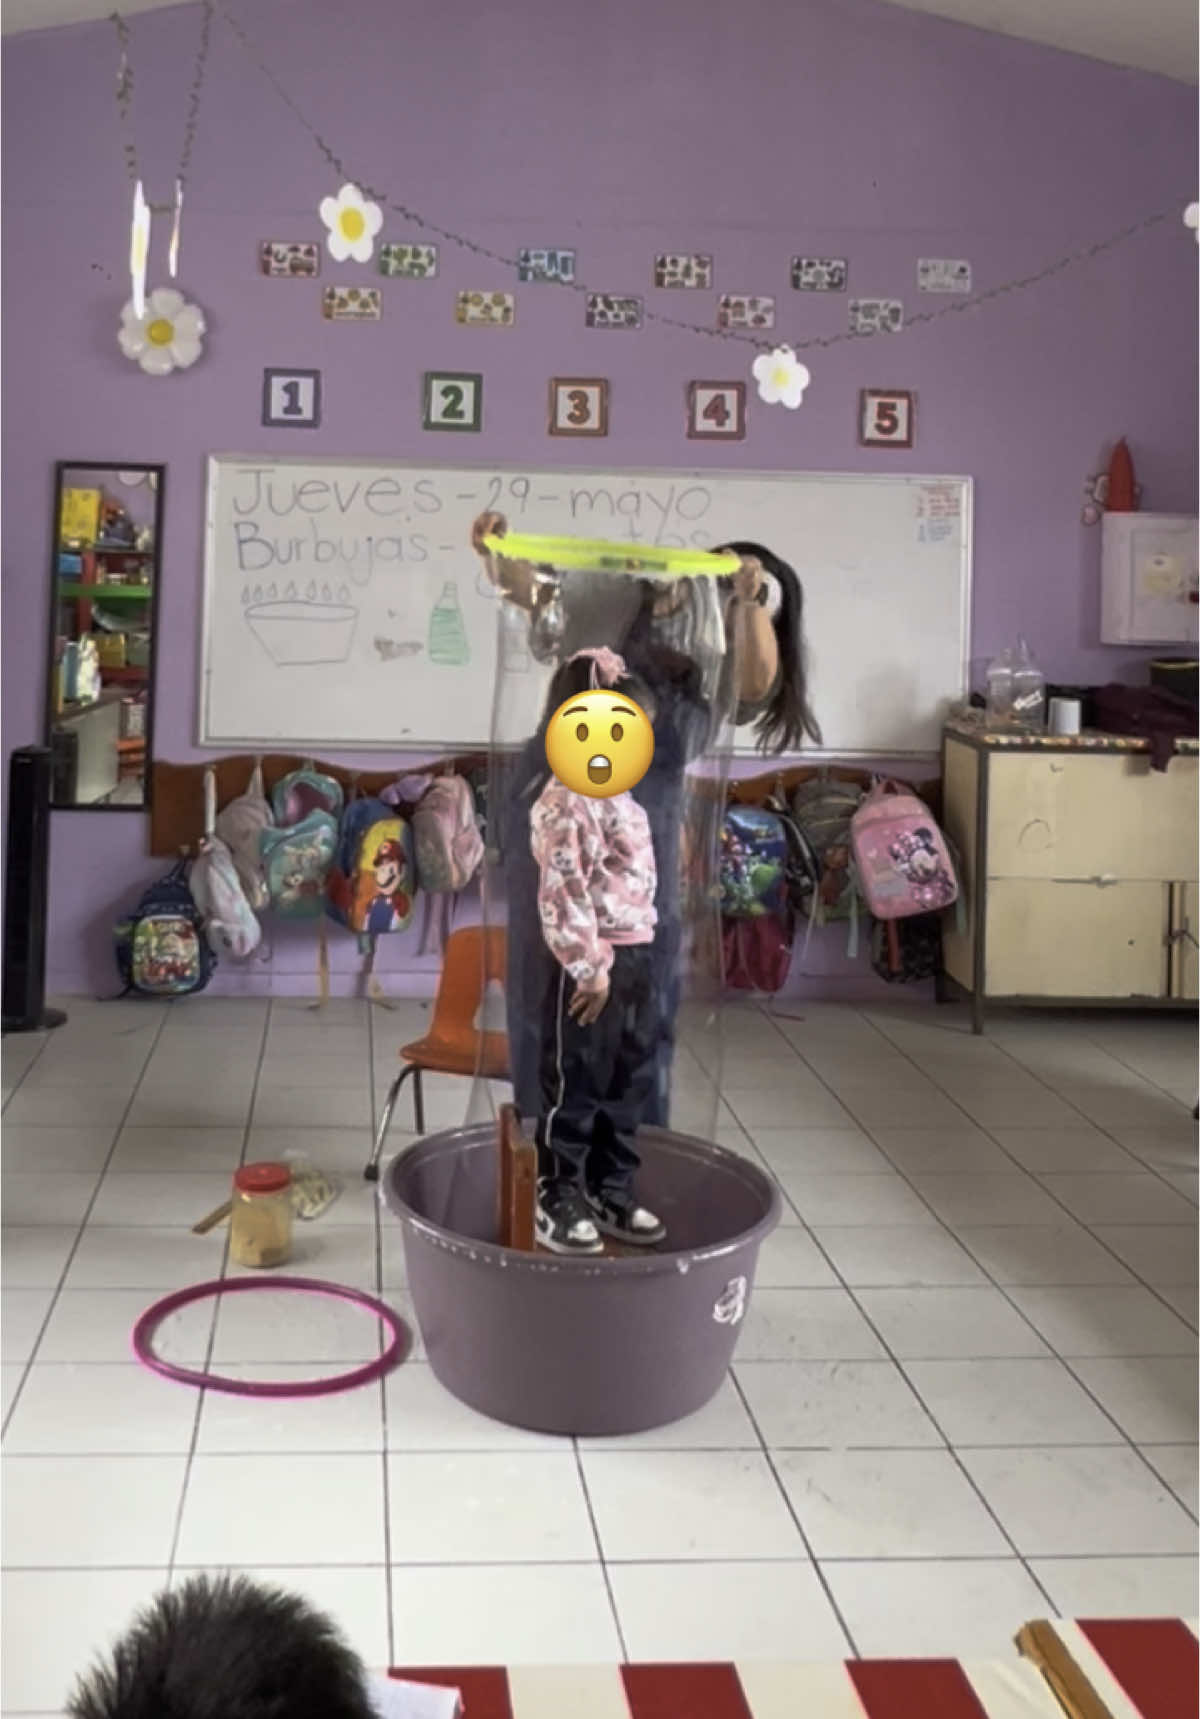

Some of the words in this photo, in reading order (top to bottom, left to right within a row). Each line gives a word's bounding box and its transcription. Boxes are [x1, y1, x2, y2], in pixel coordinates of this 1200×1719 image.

[281, 381, 303, 415] 1
[439, 385, 465, 419] 2
[567, 390, 591, 425] 3
[702, 394, 730, 427] 4
[874, 402, 899, 436] 5
